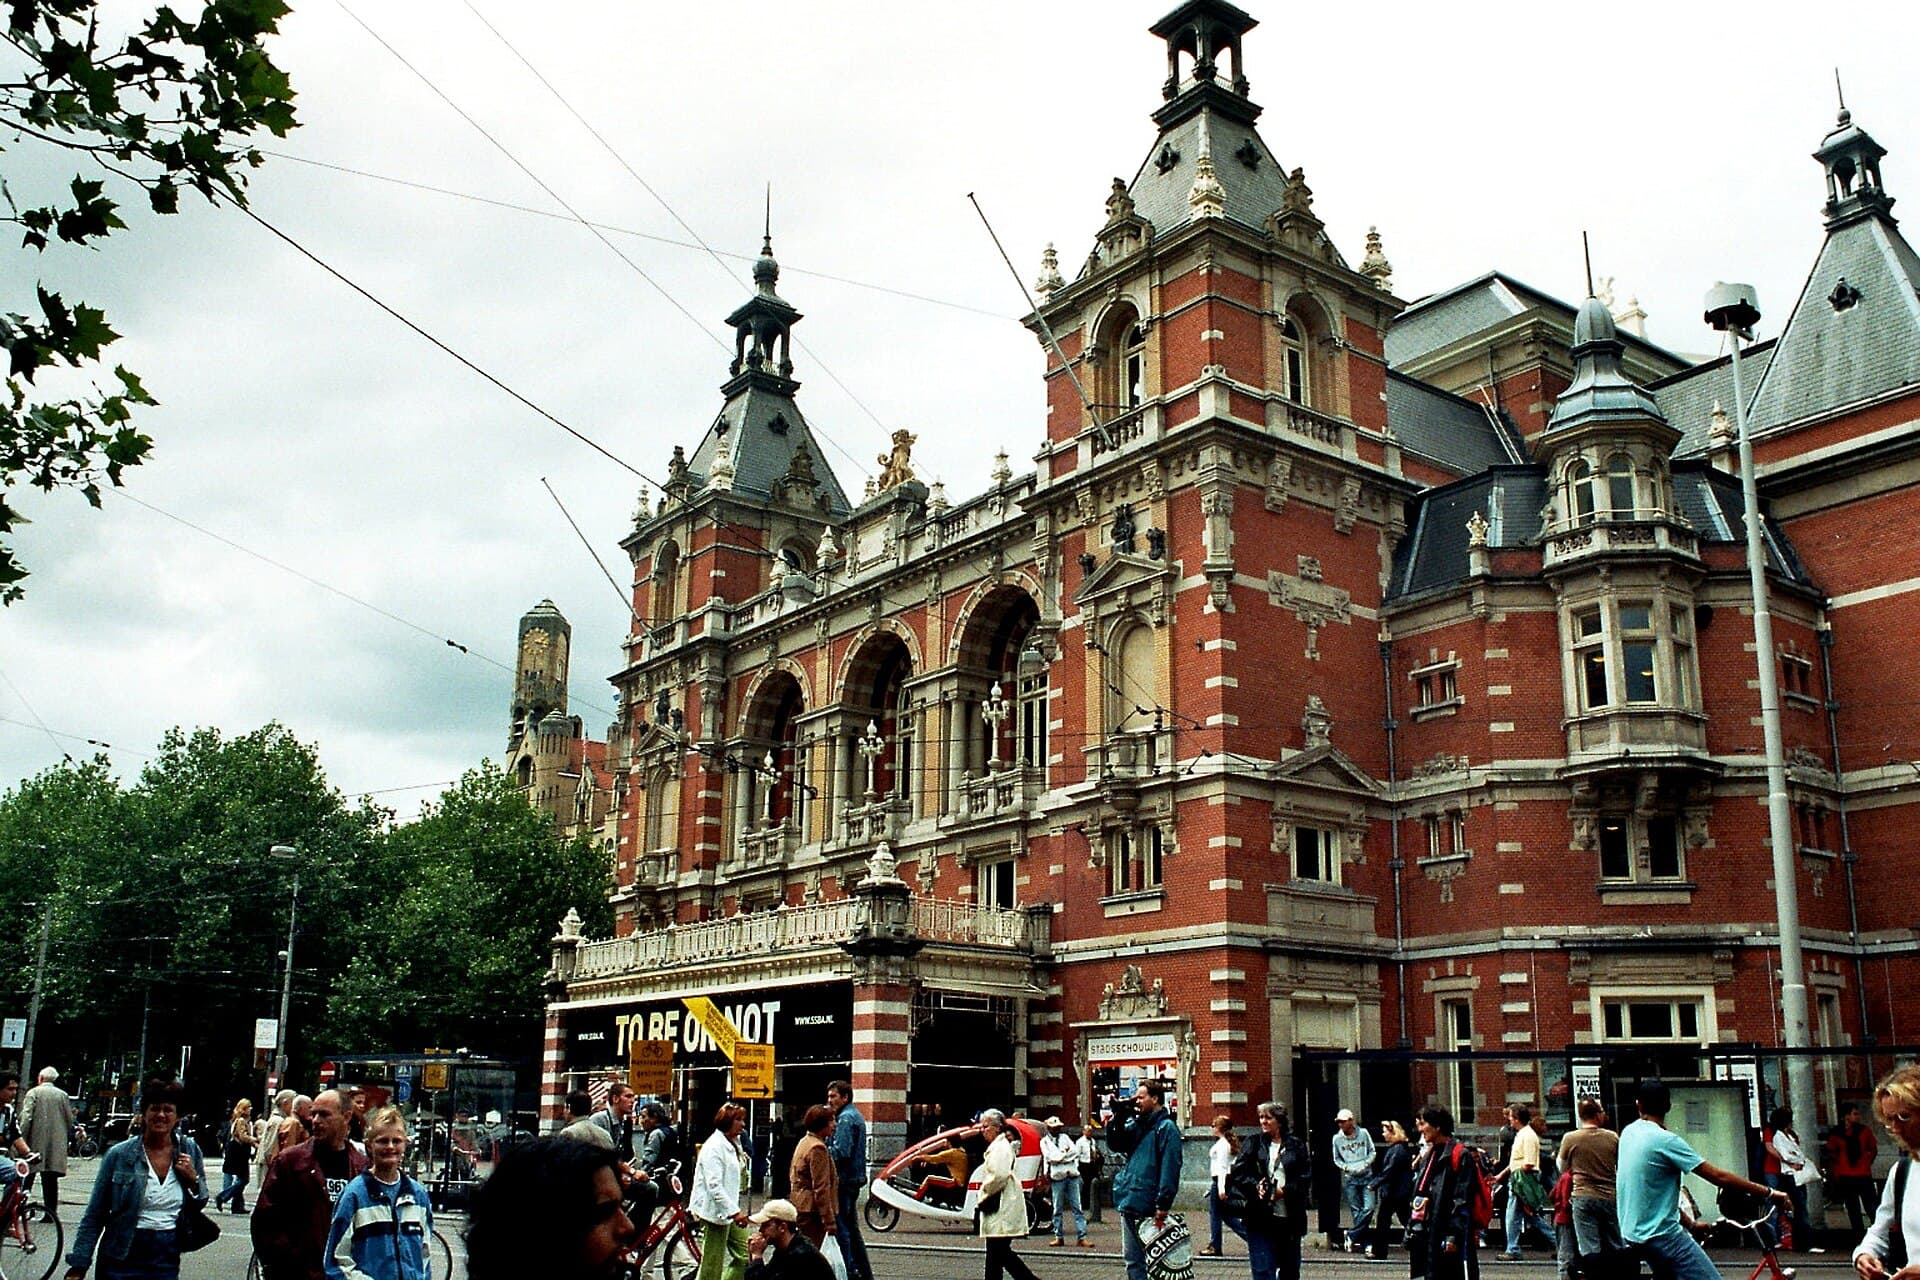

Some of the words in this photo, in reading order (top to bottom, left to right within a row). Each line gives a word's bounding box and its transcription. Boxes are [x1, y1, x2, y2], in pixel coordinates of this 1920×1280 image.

[615, 1013, 643, 1056] TO
[648, 1010, 680, 1053] BE
[724, 1001, 780, 1044] NOT
